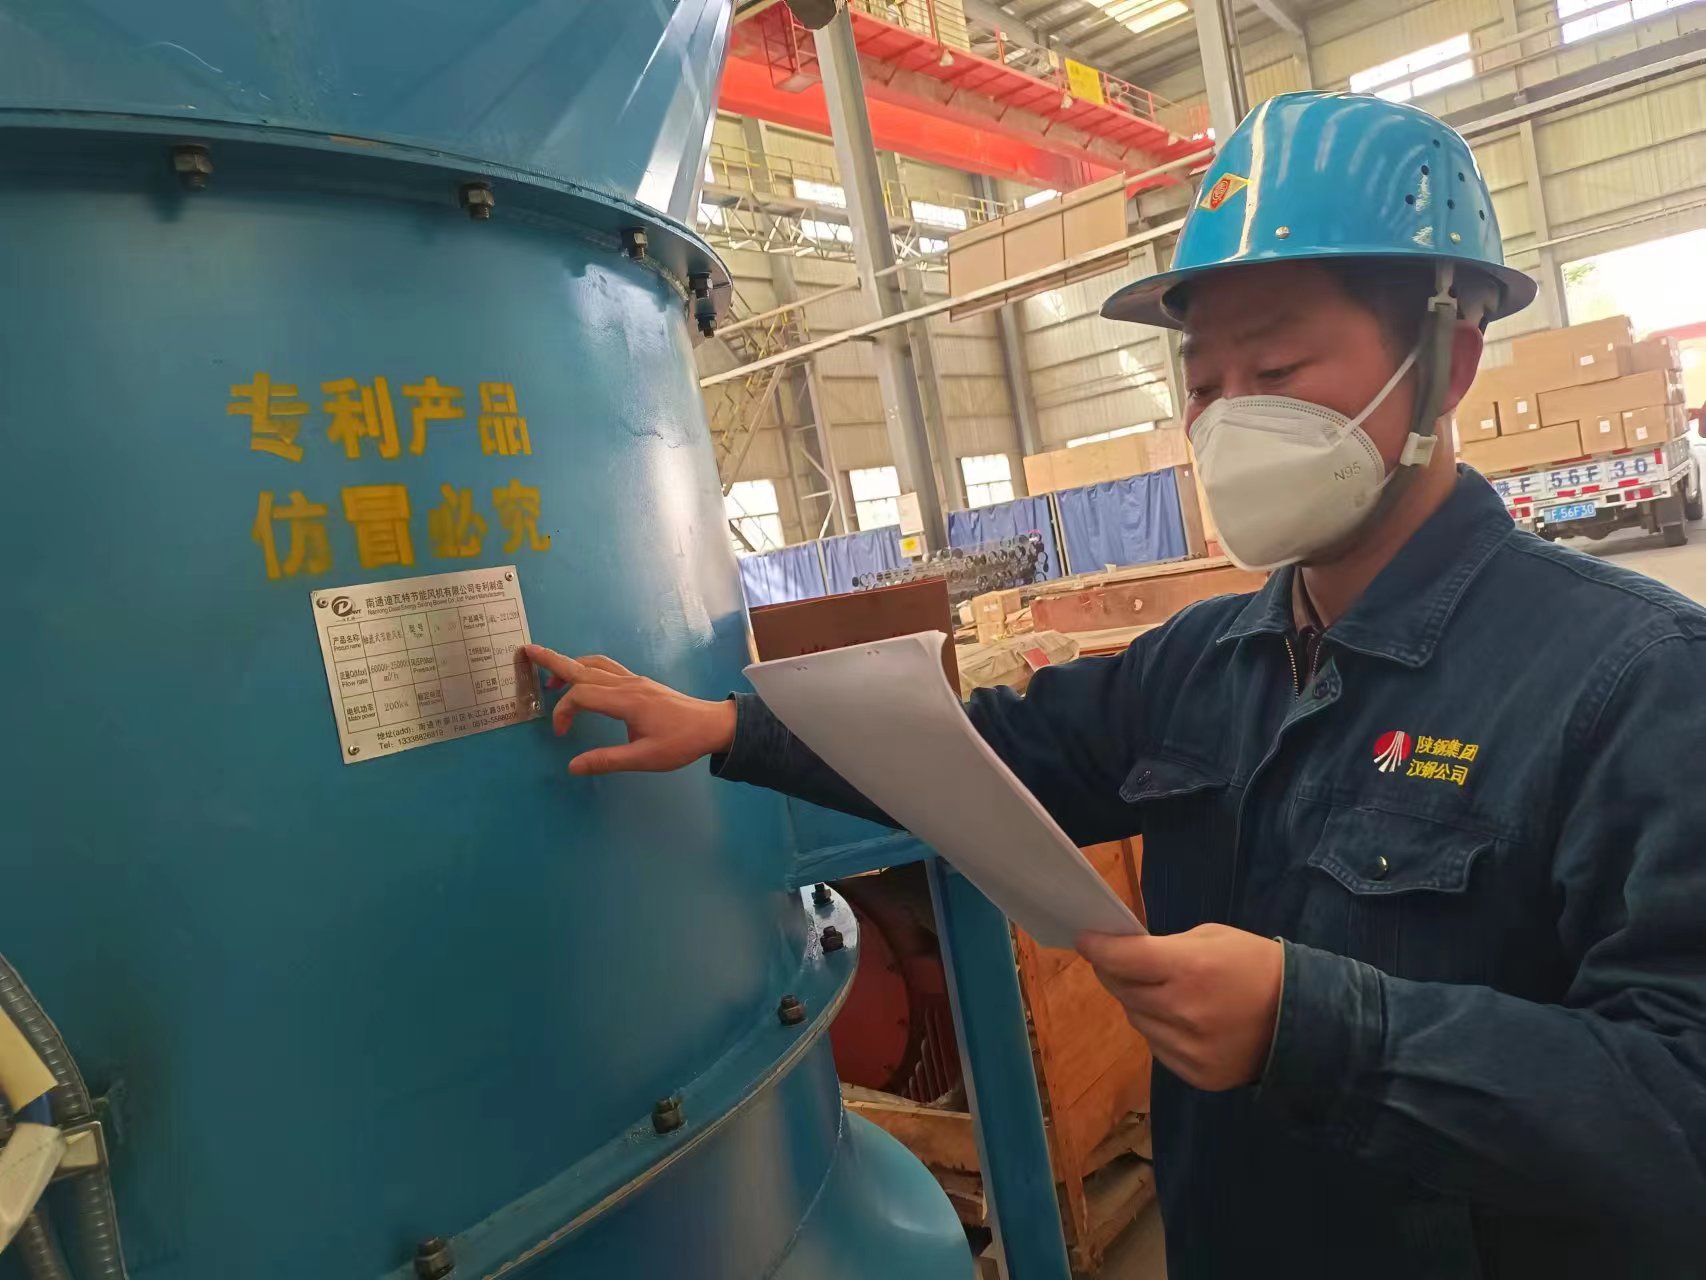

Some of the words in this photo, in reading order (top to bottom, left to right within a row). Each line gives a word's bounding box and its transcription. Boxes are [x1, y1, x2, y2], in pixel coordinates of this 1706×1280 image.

[227, 371, 532, 462] 专利产品
[1334, 462, 1361, 480] N95
[252, 478, 551, 580] 仿冒必究
[331, 633, 360, 645] 产品名称
[341, 679, 355, 687] Flow
[346, 703, 374, 715] 电机功率
[361, 711, 375, 719] power
[1415, 735, 1479, 762] 陕钢集团
[1406, 759, 1468, 786] 汉钢公司
